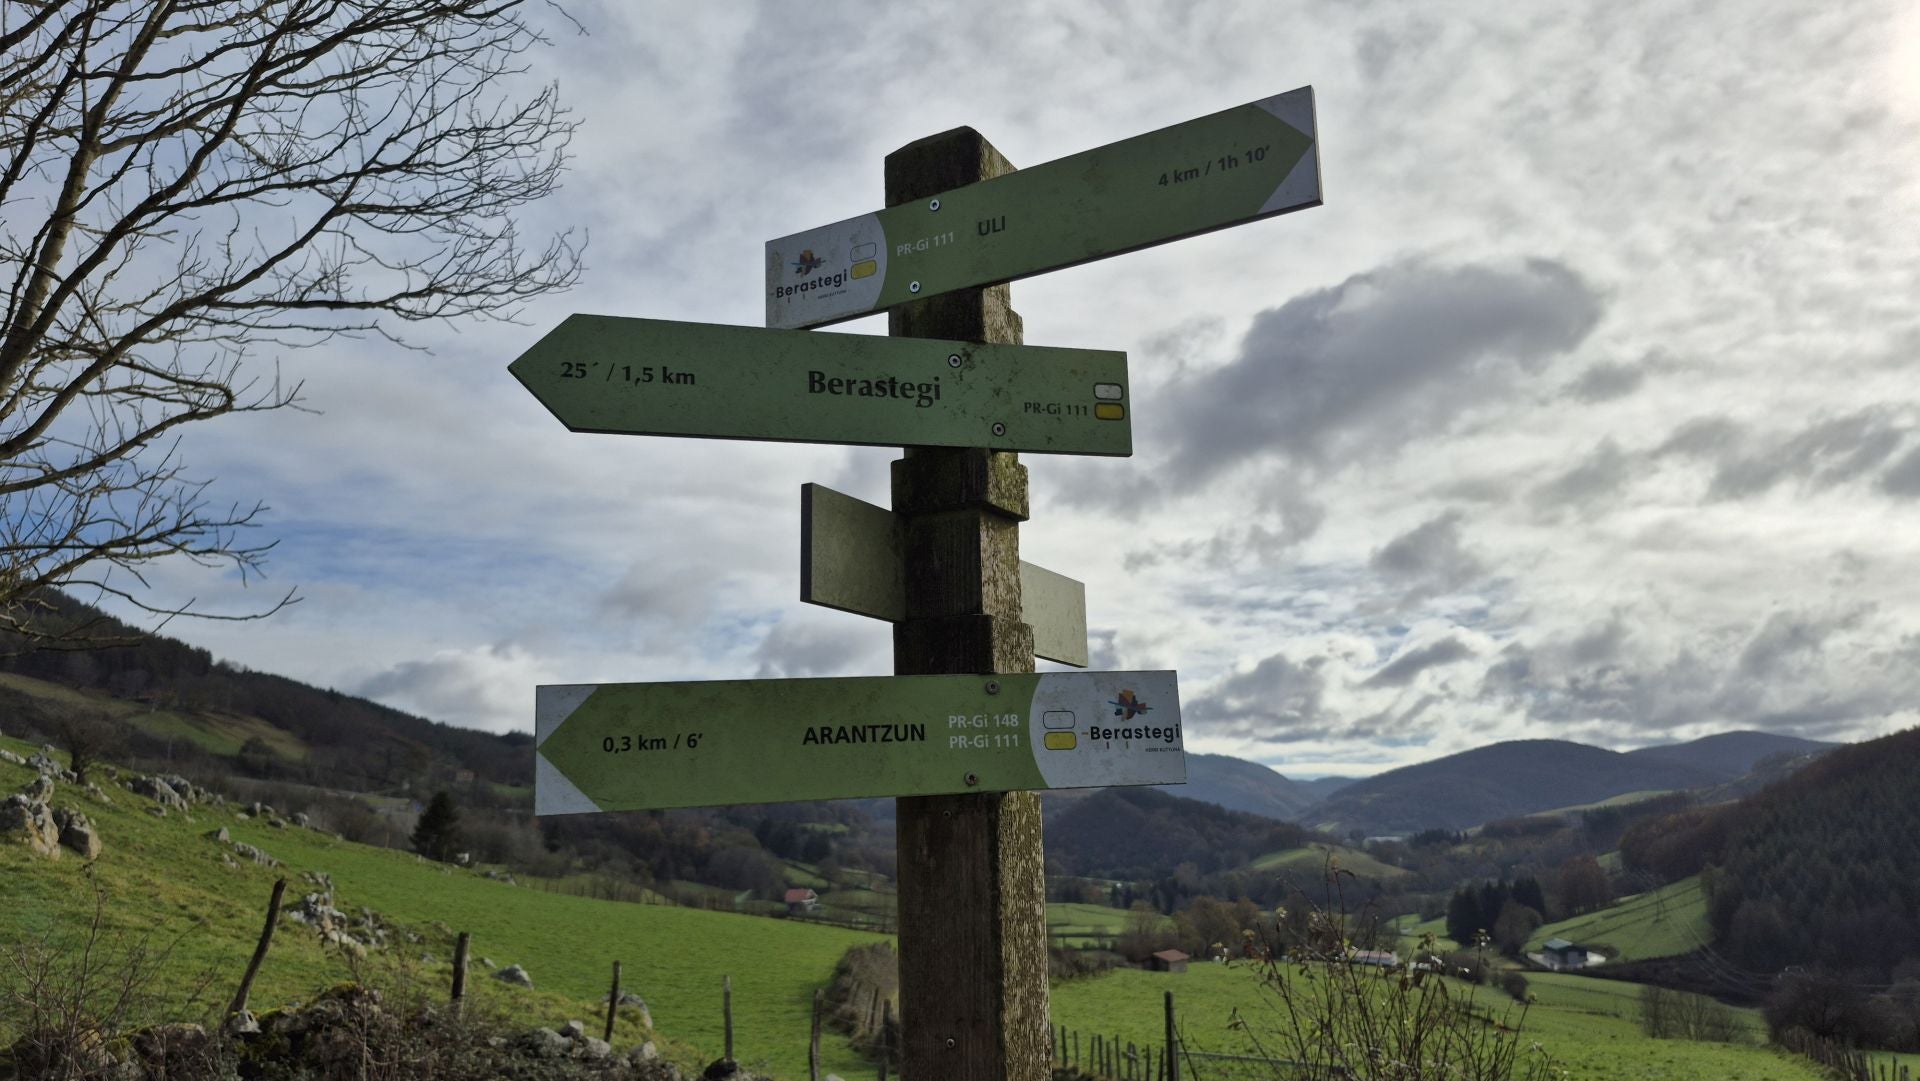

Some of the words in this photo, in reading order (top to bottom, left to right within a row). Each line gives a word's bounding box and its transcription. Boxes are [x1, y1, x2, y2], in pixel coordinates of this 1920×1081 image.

[1158, 173, 1169, 186] 4
[1173, 169, 1200, 184] km
[1204, 160, 1212, 176] /
[1217, 155, 1239, 171] 1h
[977, 215, 1006, 236] ULI
[896, 238, 929, 257] PR-Gi
[933, 231, 954, 247] 111
[775, 268, 847, 299] Berastegi
[606, 362, 615, 382] /
[621, 365, 654, 387] 1,5
[662, 366, 695, 385] km
[808, 370, 941, 409] Berastegi
[1023, 401, 1062, 415] PR-Gi
[1066, 404, 1088, 417] 111
[948, 713, 988, 728] PR-Gi
[993, 713, 1019, 728] 148
[602, 736, 632, 754] 0,3
[638, 735, 667, 751] km
[673, 733, 681, 750] /
[802, 723, 925, 745] ARANTZUN
[949, 734, 989, 749] PR-Gi
[994, 734, 1019, 748] 111
[1090, 723, 1180, 744] Berastegi
